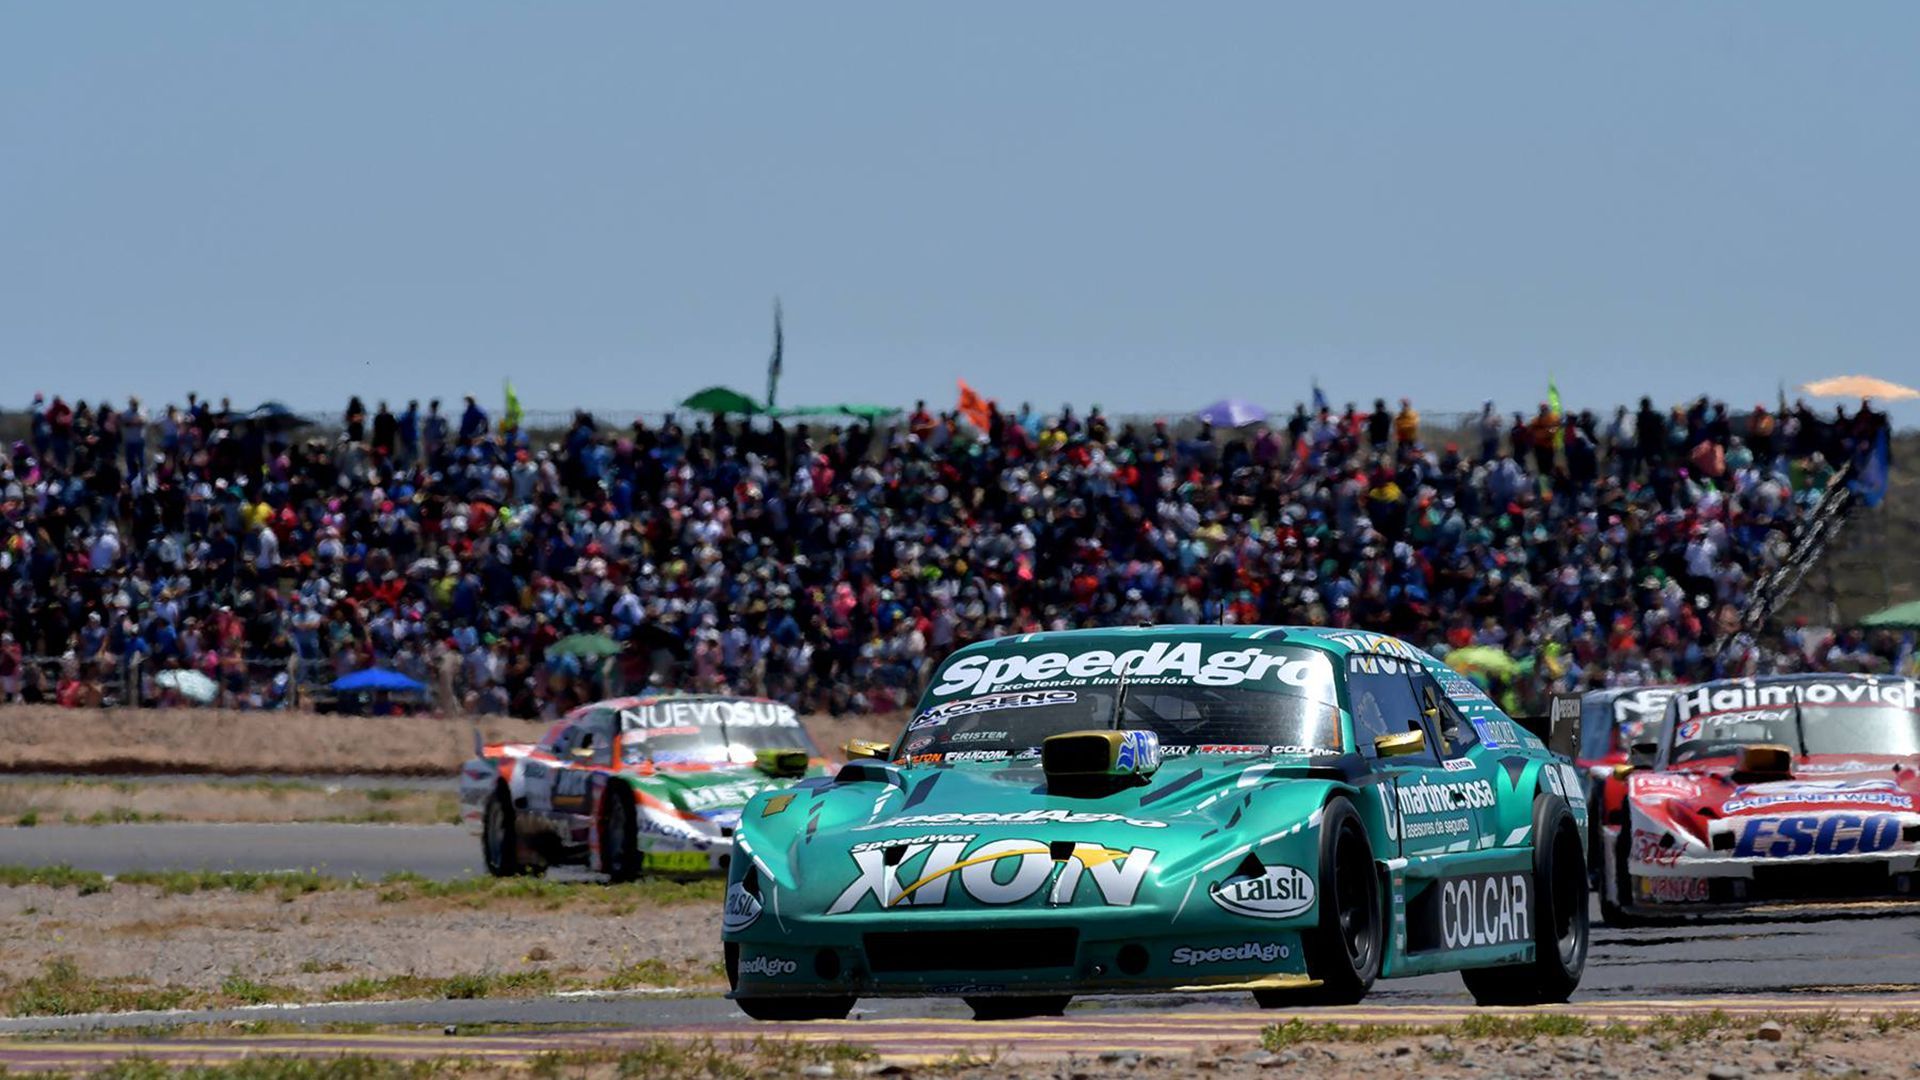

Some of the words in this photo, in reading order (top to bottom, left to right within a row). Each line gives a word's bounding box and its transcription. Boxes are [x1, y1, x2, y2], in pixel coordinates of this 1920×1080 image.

[932, 641, 1327, 696] SpeedAgro
[991, 678, 1087, 693] Excelencia
[1091, 676, 1189, 687] Innovación
[620, 701, 799, 731] NUEVOSUR
[911, 691, 1076, 725] MORENO
[951, 731, 1008, 742] CRISTEM
[1406, 821, 1436, 838] asesores
[1435, 818, 1443, 834] de
[1444, 818, 1470, 836] seguros
[852, 834, 976, 852] SpeedWet
[825, 838, 1158, 914] XION
[1442, 875, 1530, 949] COLCAR
[1172, 942, 1290, 966] SpeedAgro
